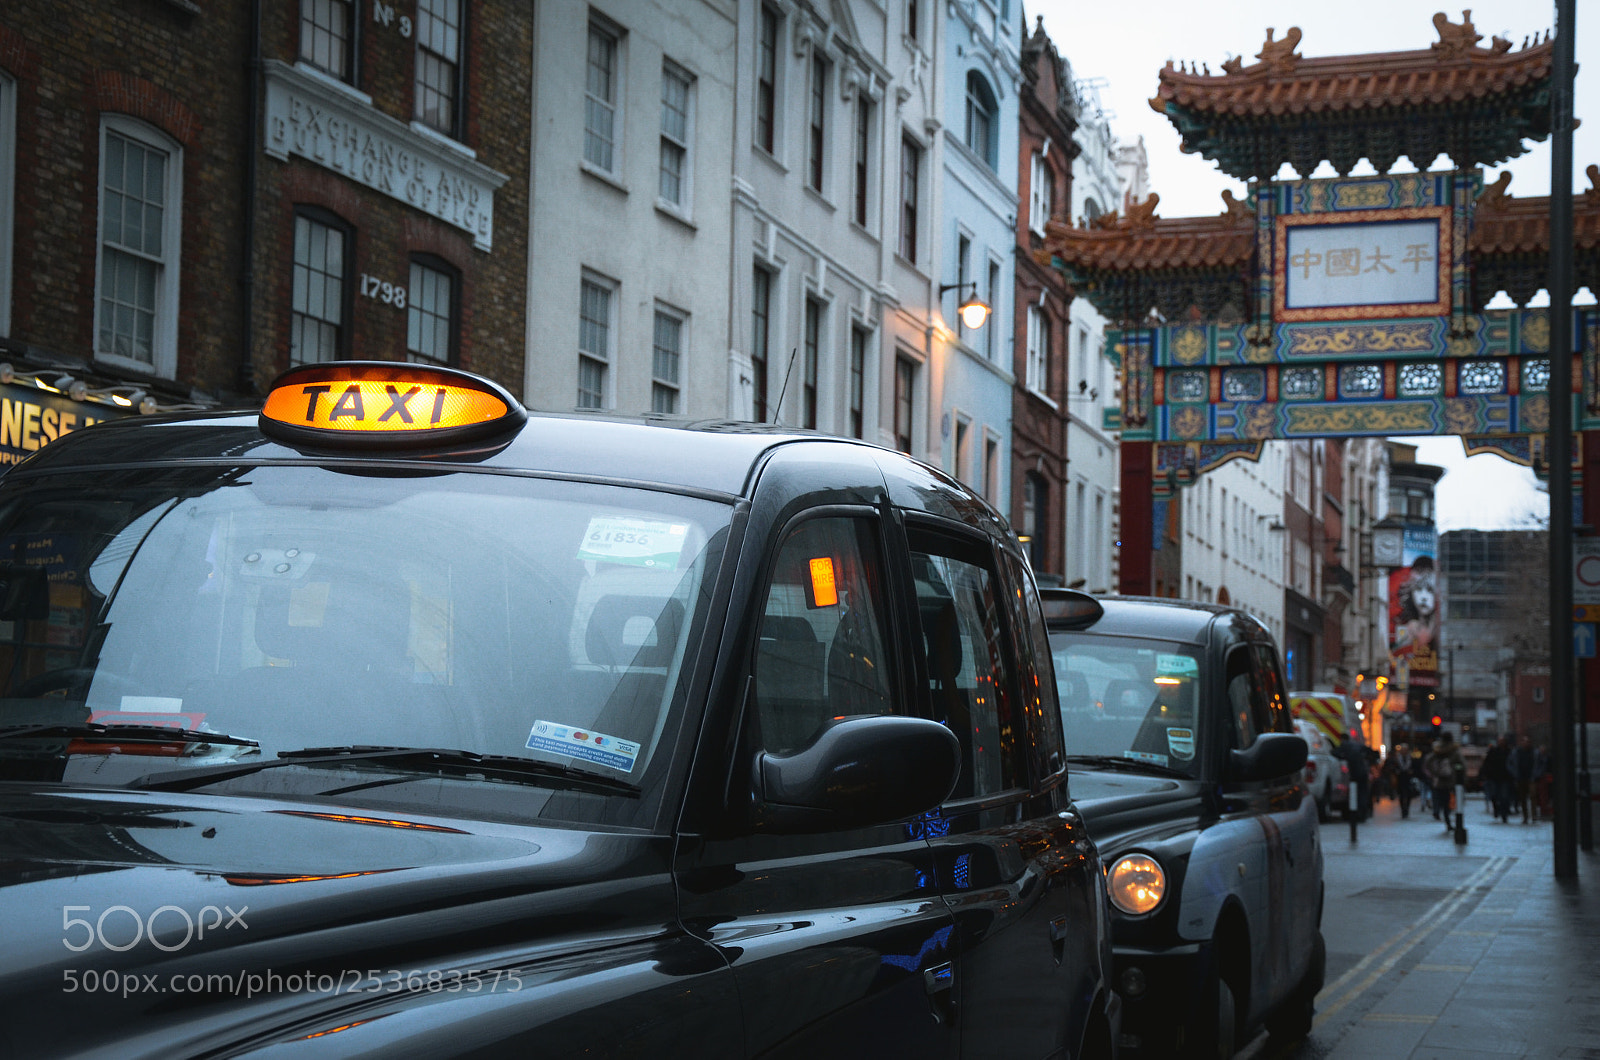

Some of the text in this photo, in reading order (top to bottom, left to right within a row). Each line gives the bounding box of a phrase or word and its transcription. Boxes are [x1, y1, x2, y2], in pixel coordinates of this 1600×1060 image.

[399, 15, 412, 38] 9
[286, 94, 480, 209] EXCHANGE AND
[273, 116, 489, 236] BULLION OFFICE
[1291, 243, 1434, 280] 中國太平
[360, 272, 406, 309] 1798
[302, 384, 447, 424] TAXI
[589, 530, 649, 545] 61836
